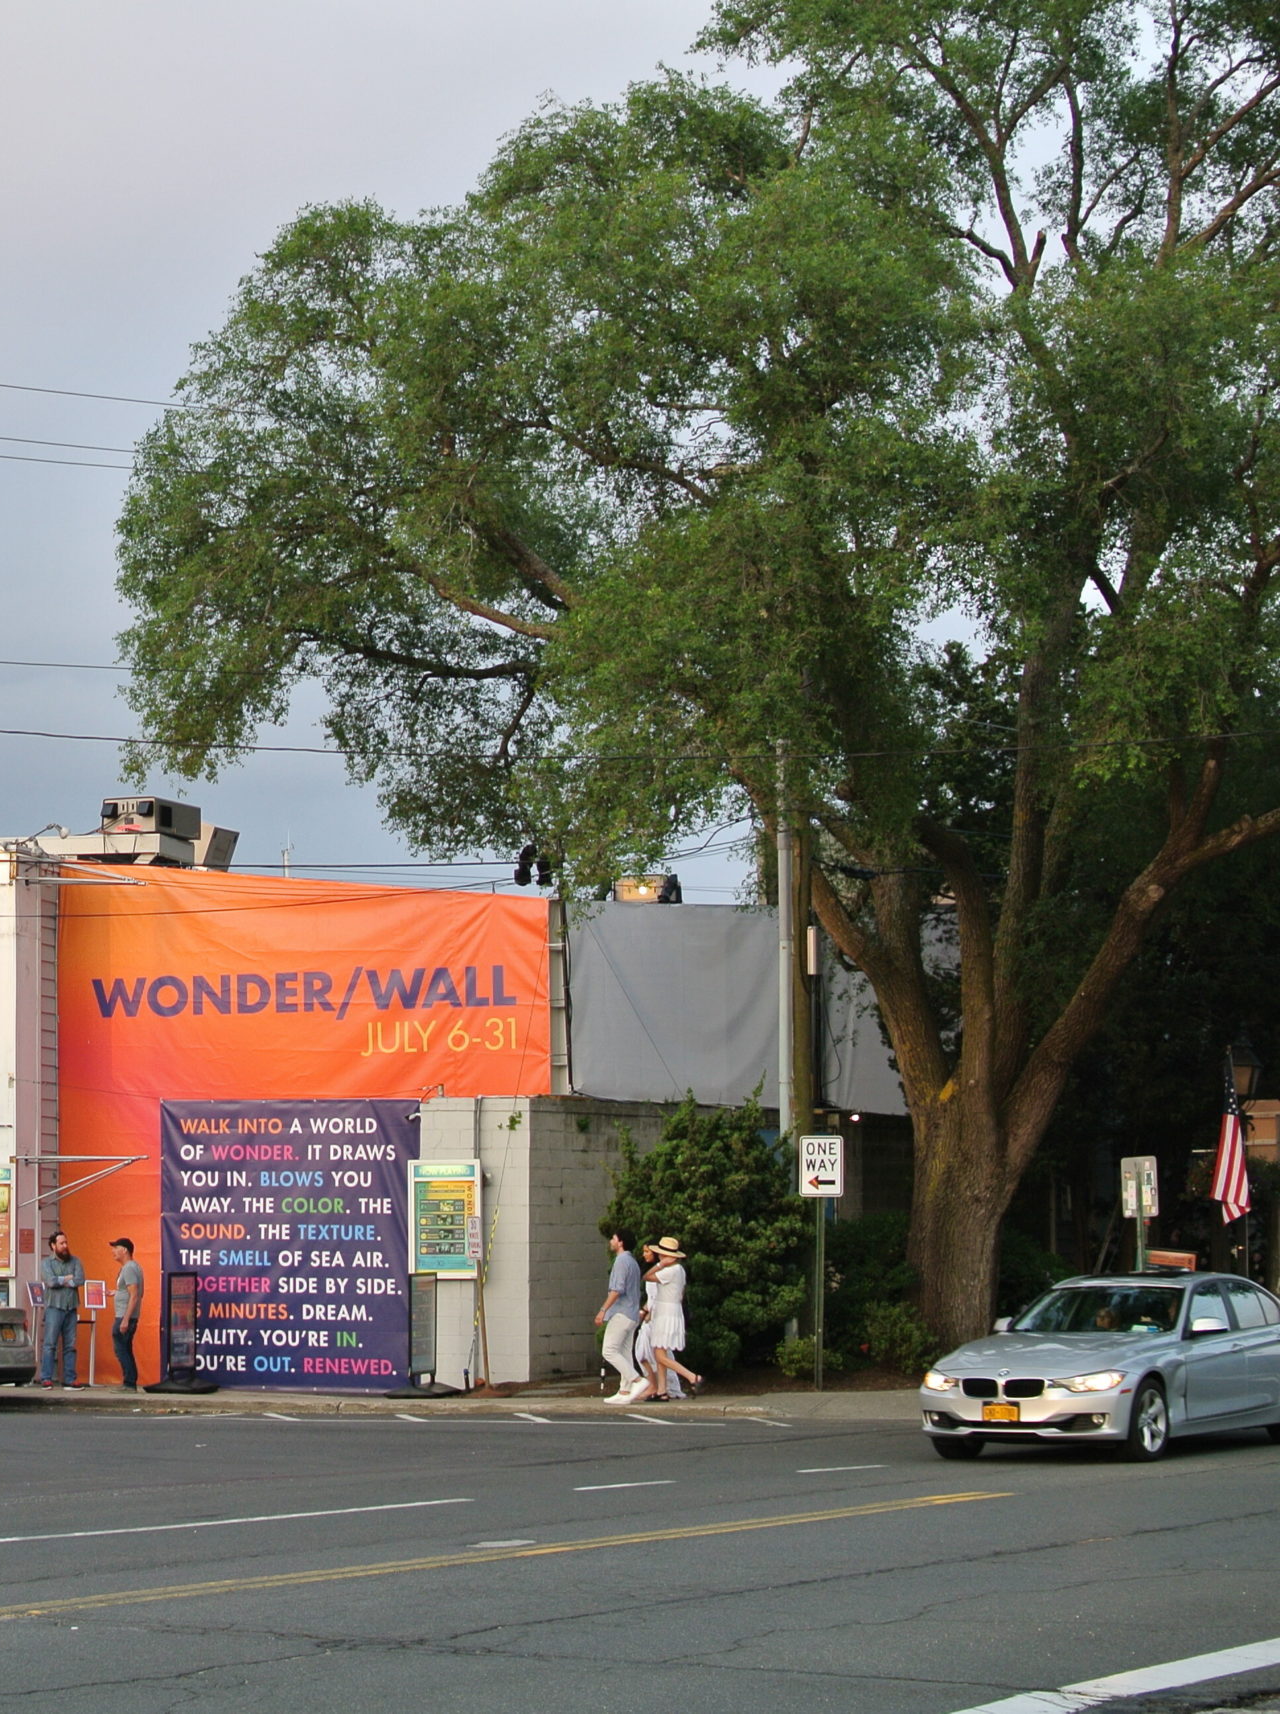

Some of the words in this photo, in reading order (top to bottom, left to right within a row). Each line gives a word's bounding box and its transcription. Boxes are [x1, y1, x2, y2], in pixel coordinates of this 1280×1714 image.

[91, 964, 517, 1020] WONDER/WALL
[360, 1019, 437, 1057] JULY
[447, 1017, 517, 1052] 6-31
[180, 1118, 231, 1135] WALK
[238, 1118, 283, 1134] INTO
[289, 1118, 303, 1134] A
[309, 1117, 377, 1134] WORLD
[180, 1144, 204, 1161] OF
[211, 1144, 300, 1161] WONDER.
[307, 1144, 322, 1160] IT
[329, 1144, 396, 1161] DRAWS
[806, 1142, 837, 1156] ONE
[805, 1158, 838, 1172] WAY
[180, 1170, 219, 1187] YOU
[226, 1170, 252, 1187] IN.
[260, 1171, 324, 1187] BLOWS
[331, 1170, 372, 1187] YOU
[180, 1197, 235, 1213] AWAY.
[243, 1197, 274, 1213] THE
[281, 1197, 351, 1214] COLOR.
[358, 1198, 392, 1214] THE
[180, 1223, 251, 1240] SOUND.
[258, 1224, 290, 1240] THE
[297, 1224, 382, 1241] TEXTURE.
[179, 1249, 211, 1266] THE
[218, 1250, 271, 1266] SMELL
[278, 1251, 303, 1267] OF
[310, 1251, 345, 1267] SEA
[352, 1251, 389, 1268] AIR.
[196, 1276, 270, 1293] GETHER
[278, 1277, 317, 1293] SIDE
[325, 1277, 348, 1294] BY
[356, 1278, 402, 1295] SIDE.
[208, 1302, 294, 1320] MINUTES.
[302, 1303, 373, 1321] DREAM.
[196, 1328, 252, 1346] ALITY.
[260, 1329, 329, 1347] YOU'RE
[336, 1330, 363, 1348] IN.
[195, 1354, 246, 1371] OU'RE
[253, 1355, 296, 1373] OUT.
[303, 1356, 397, 1375] RENEWED.
